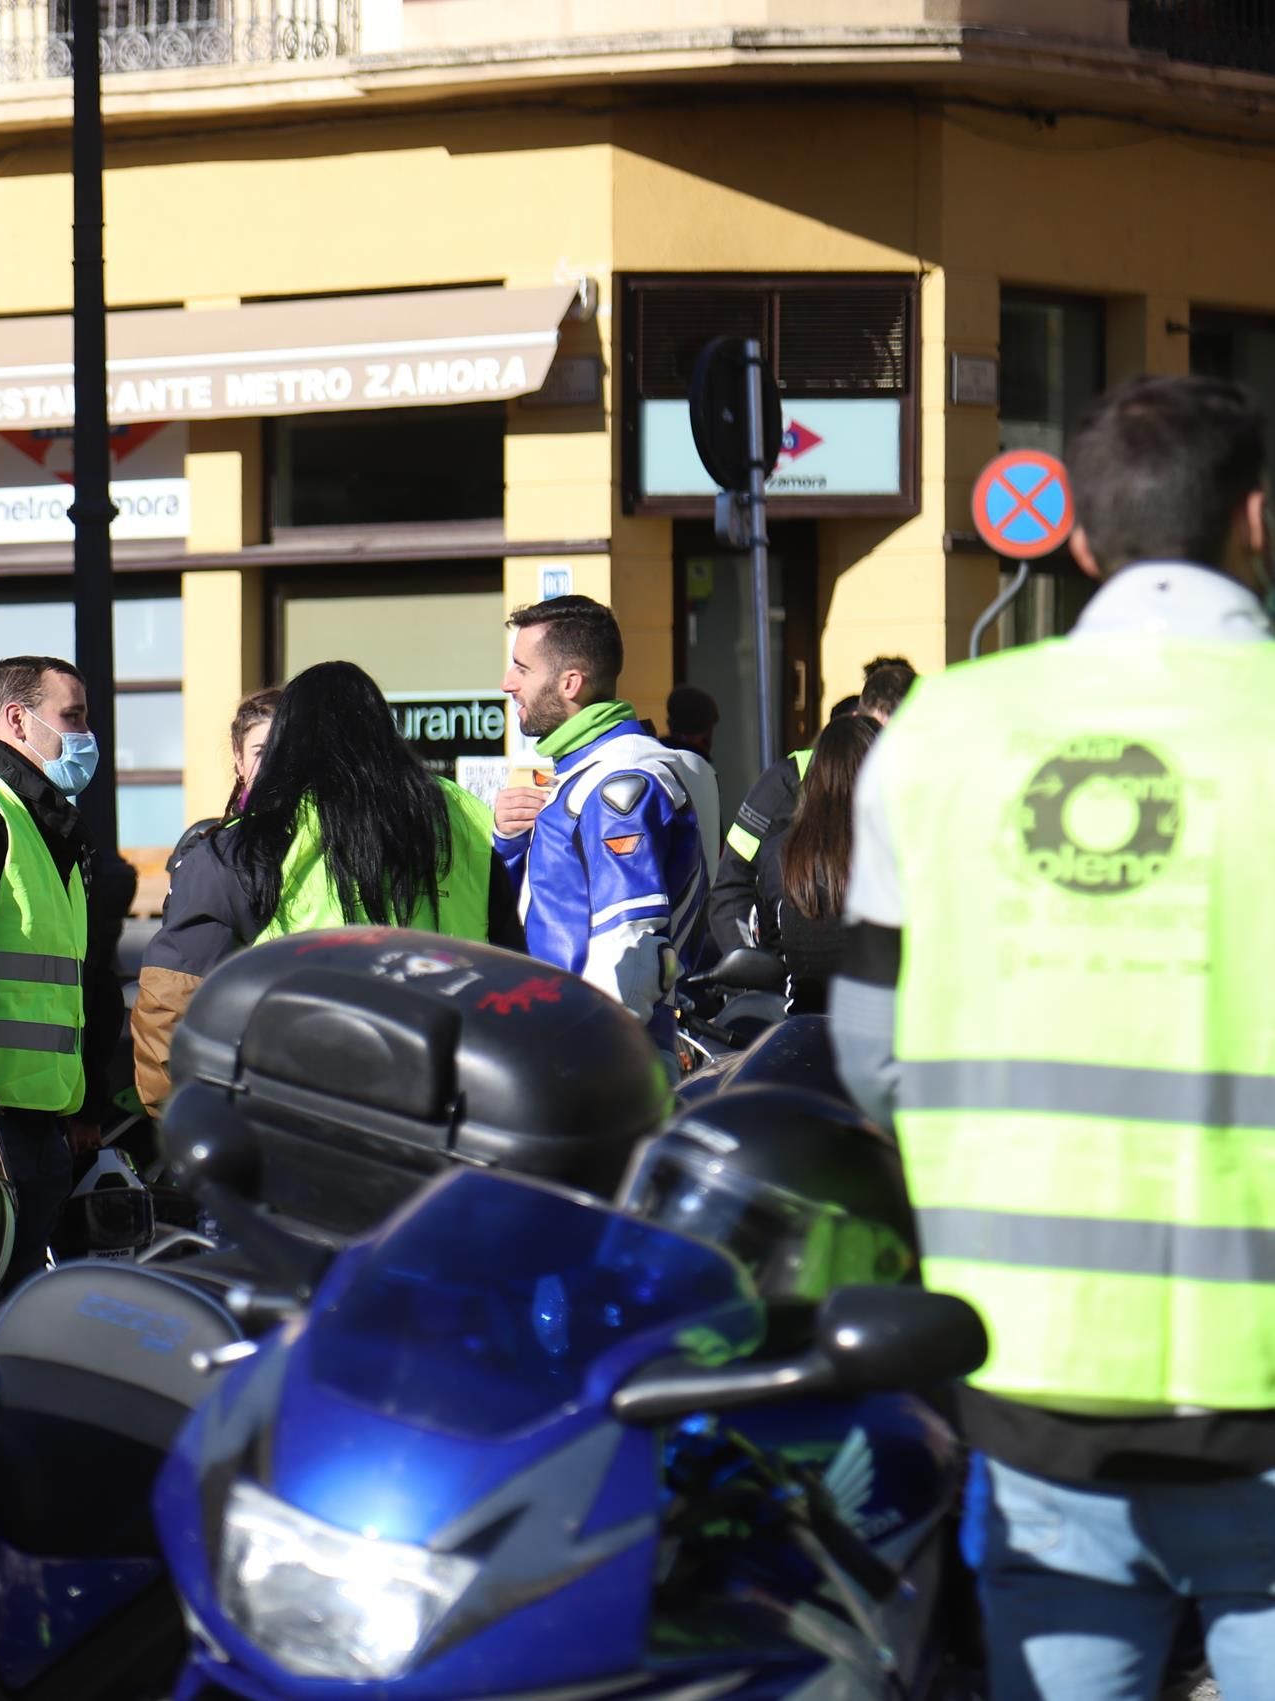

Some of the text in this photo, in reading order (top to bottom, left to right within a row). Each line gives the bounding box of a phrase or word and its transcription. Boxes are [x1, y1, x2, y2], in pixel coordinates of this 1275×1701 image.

[225, 367, 352, 407] METRO
[363, 356, 527, 400] ZAMORA
[391, 700, 505, 741] urante
